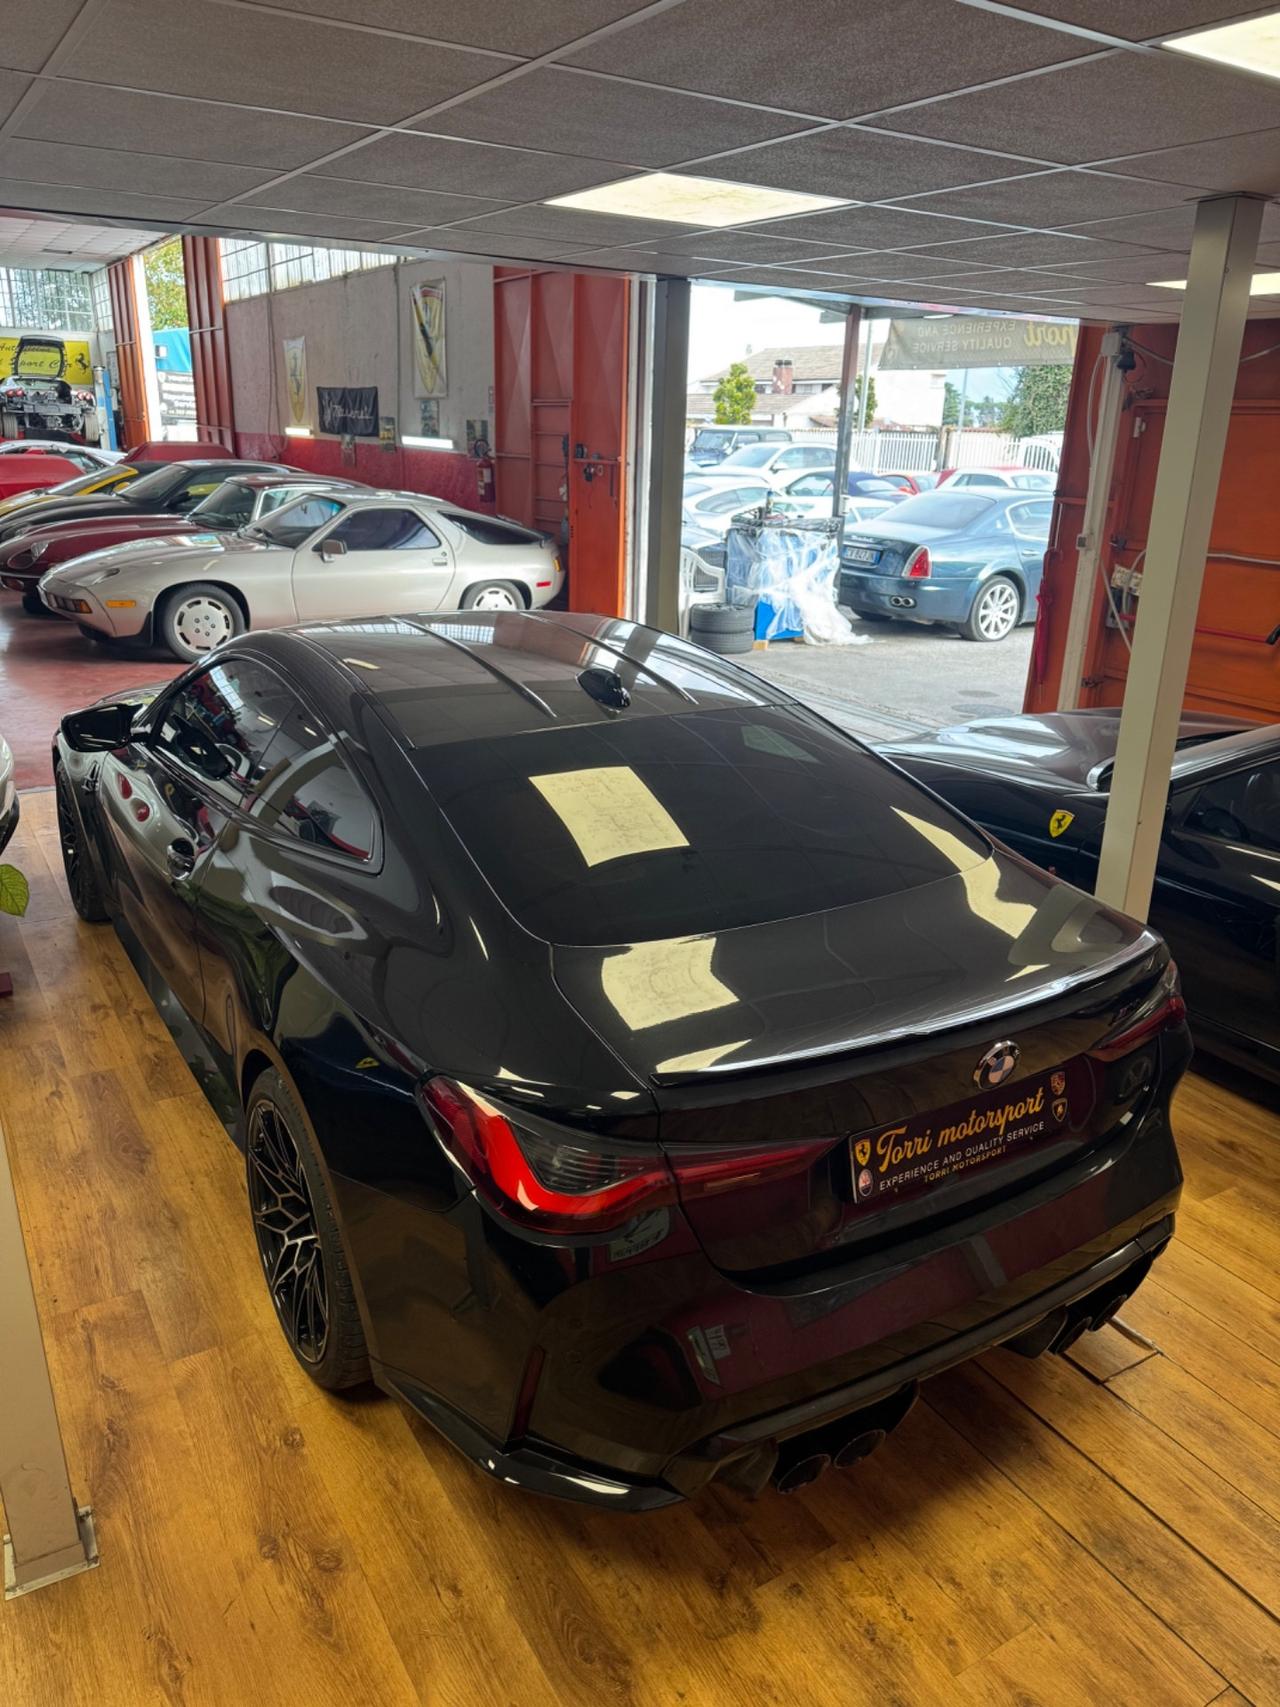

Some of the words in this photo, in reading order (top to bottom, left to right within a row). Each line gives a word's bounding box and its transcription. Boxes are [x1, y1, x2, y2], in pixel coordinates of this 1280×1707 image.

[876, 1126, 932, 1173] Torri
[937, 1086, 1044, 1147] motorsport
[879, 1159, 940, 1191] EXPERIENCE
[943, 1151, 962, 1165] AND
[965, 1138, 1004, 1157] QUALITY
[1007, 1121, 1045, 1142] SERVICE
[924, 1167, 950, 1183] TORRI
